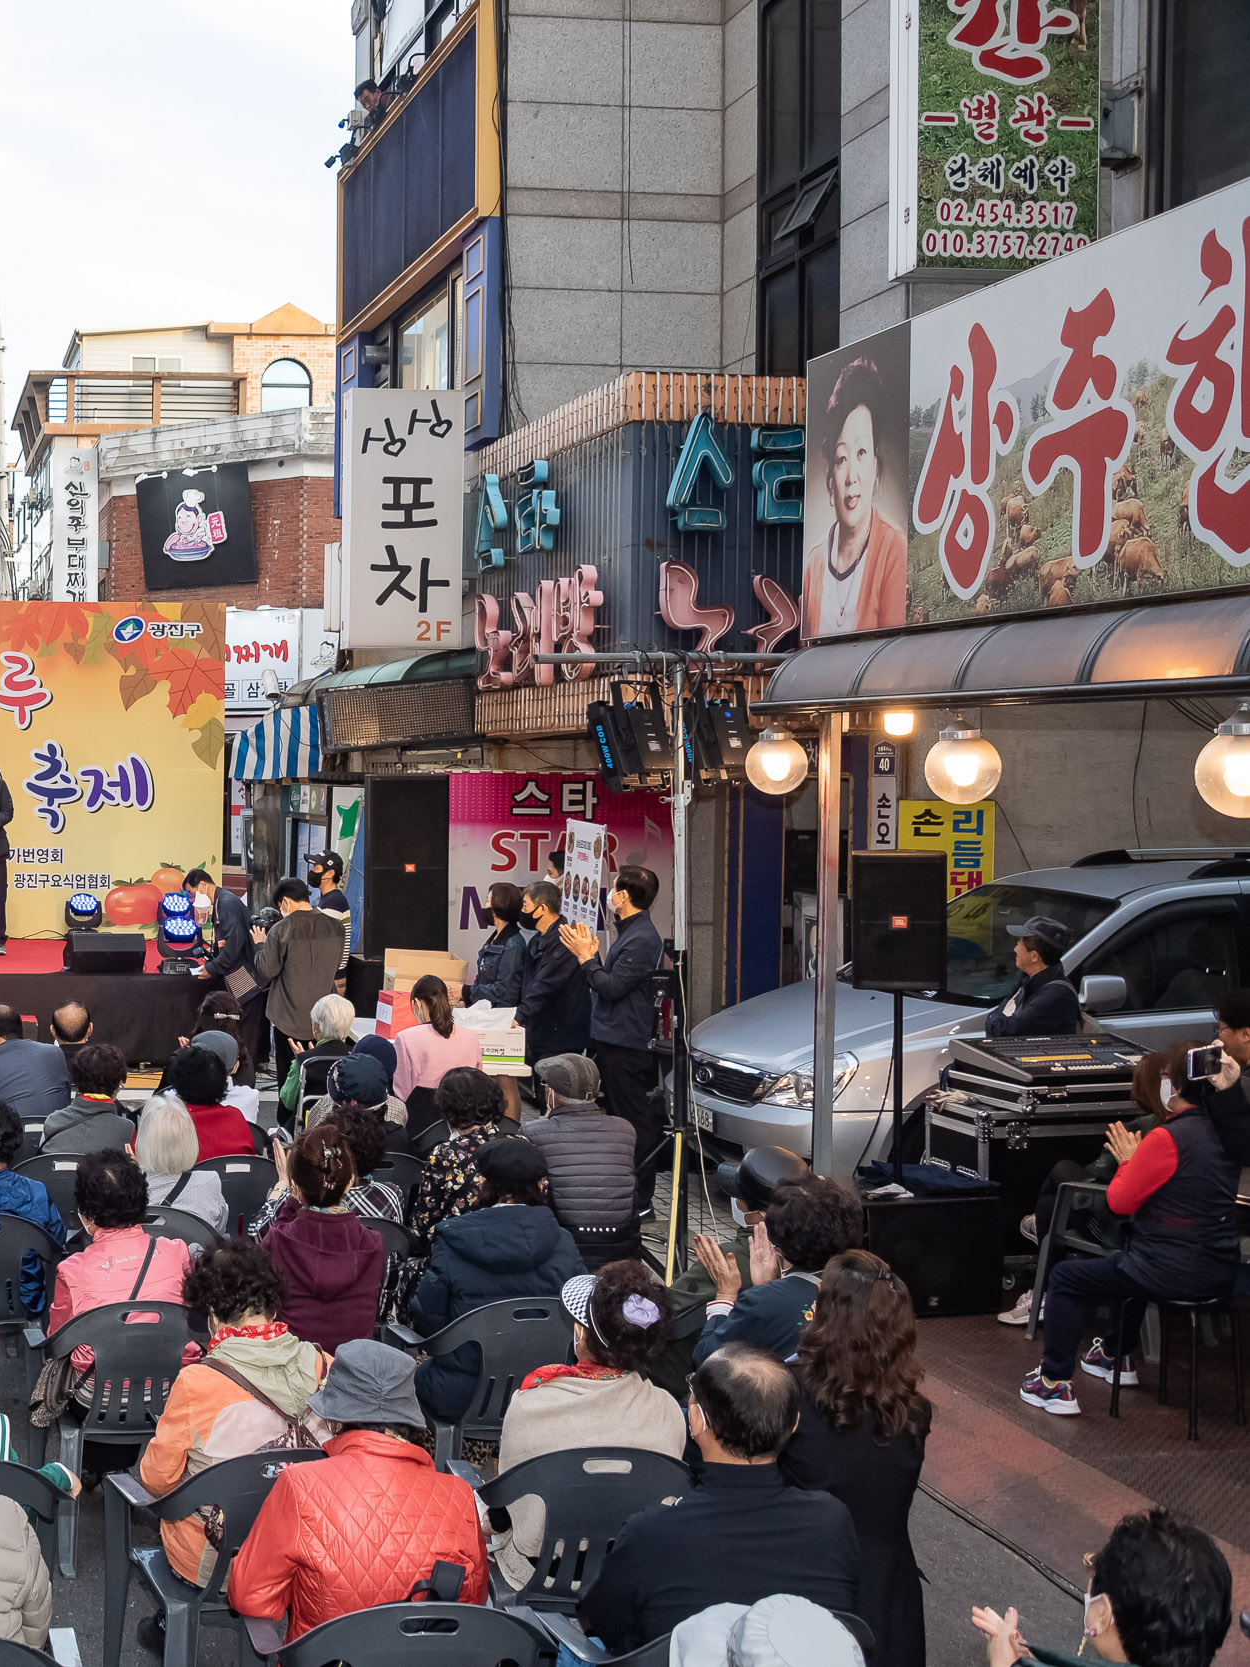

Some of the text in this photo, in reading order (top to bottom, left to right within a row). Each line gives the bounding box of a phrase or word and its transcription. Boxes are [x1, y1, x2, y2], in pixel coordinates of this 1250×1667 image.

[963, 94, 1052, 143] 별관
[940, 202, 1074, 227] 02.454.3517
[64, 481, 89, 533] 신의주
[369, 476, 450, 613] 포차
[148, 621, 203, 639] 광진구
[416, 620, 452, 642] 2F
[599, 743, 614, 769] 400W
[878, 757, 890, 772] 40
[22, 738, 157, 834] 축제
[511, 778, 598, 821] 스타
[7, 847, 64, 864] 가번영회
[13, 873, 112, 889] 광진구요식업협회
